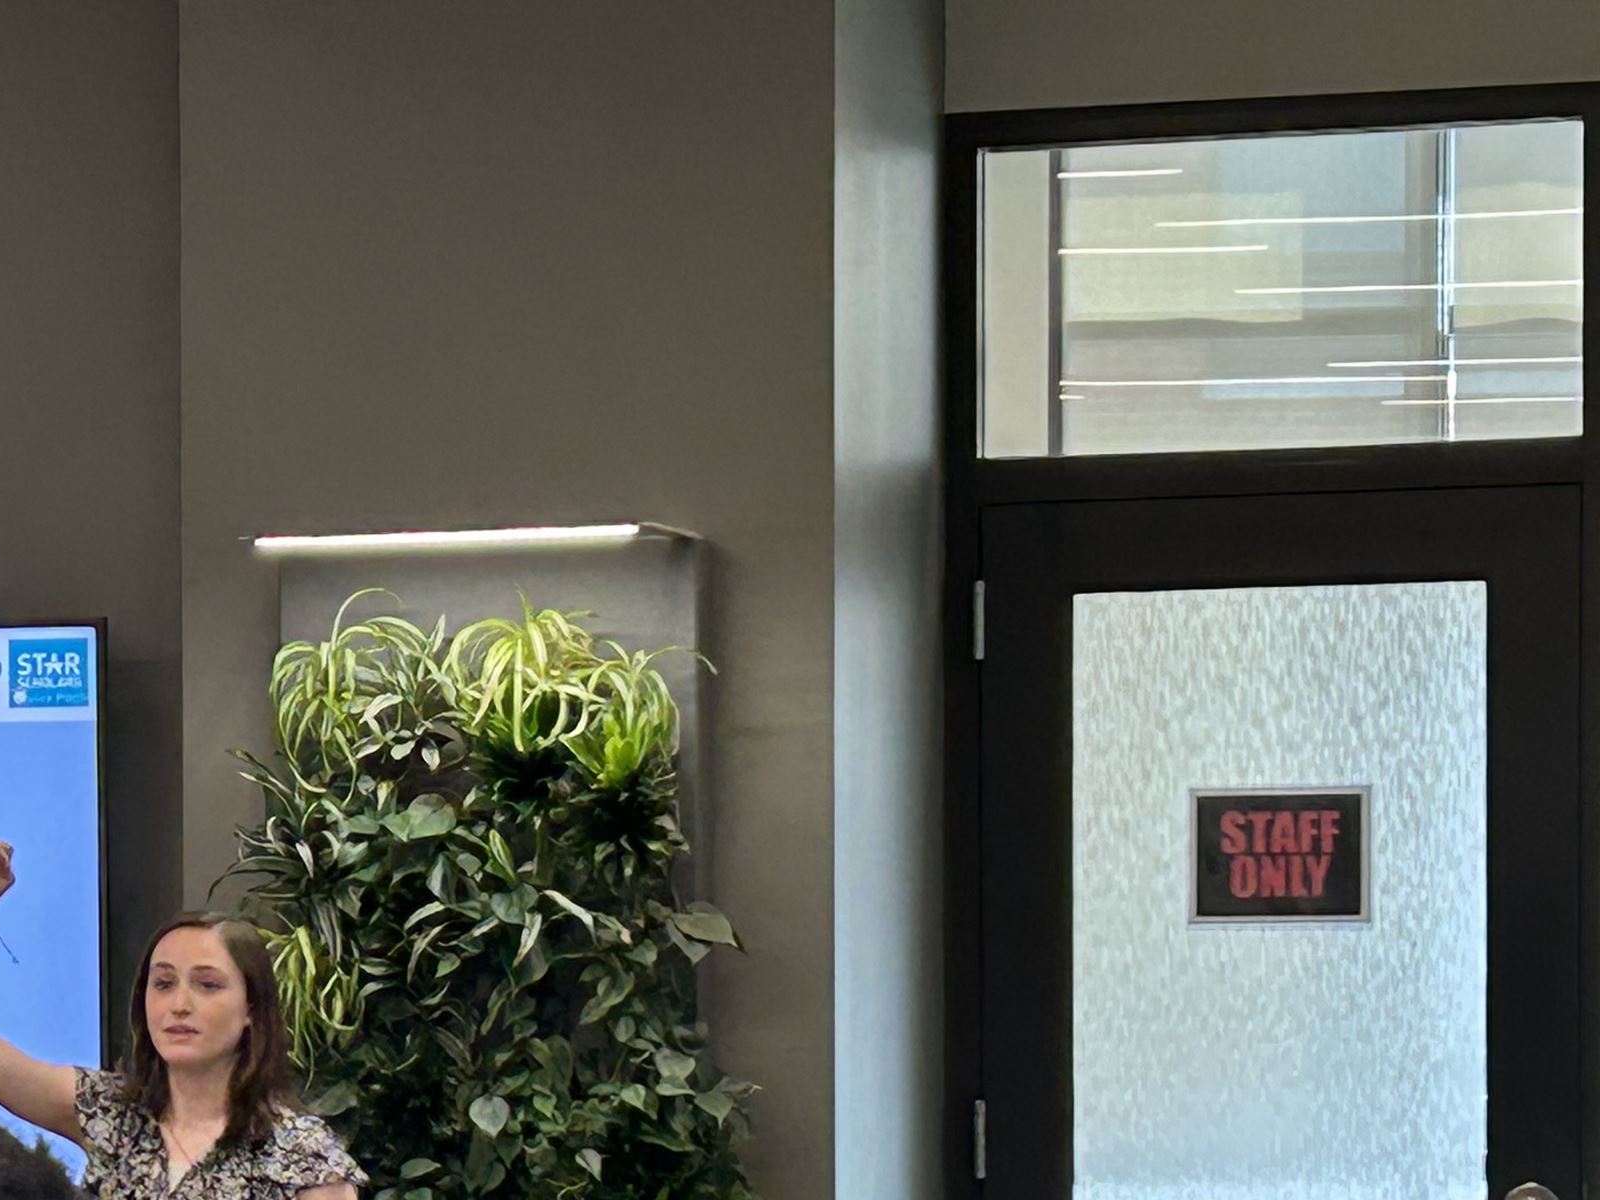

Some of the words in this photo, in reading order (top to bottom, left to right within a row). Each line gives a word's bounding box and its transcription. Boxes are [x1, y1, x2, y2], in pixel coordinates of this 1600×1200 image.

[16, 652, 82, 676] STAR
[1220, 810, 1341, 854] STAFF
[1228, 855, 1332, 899] ONLY
